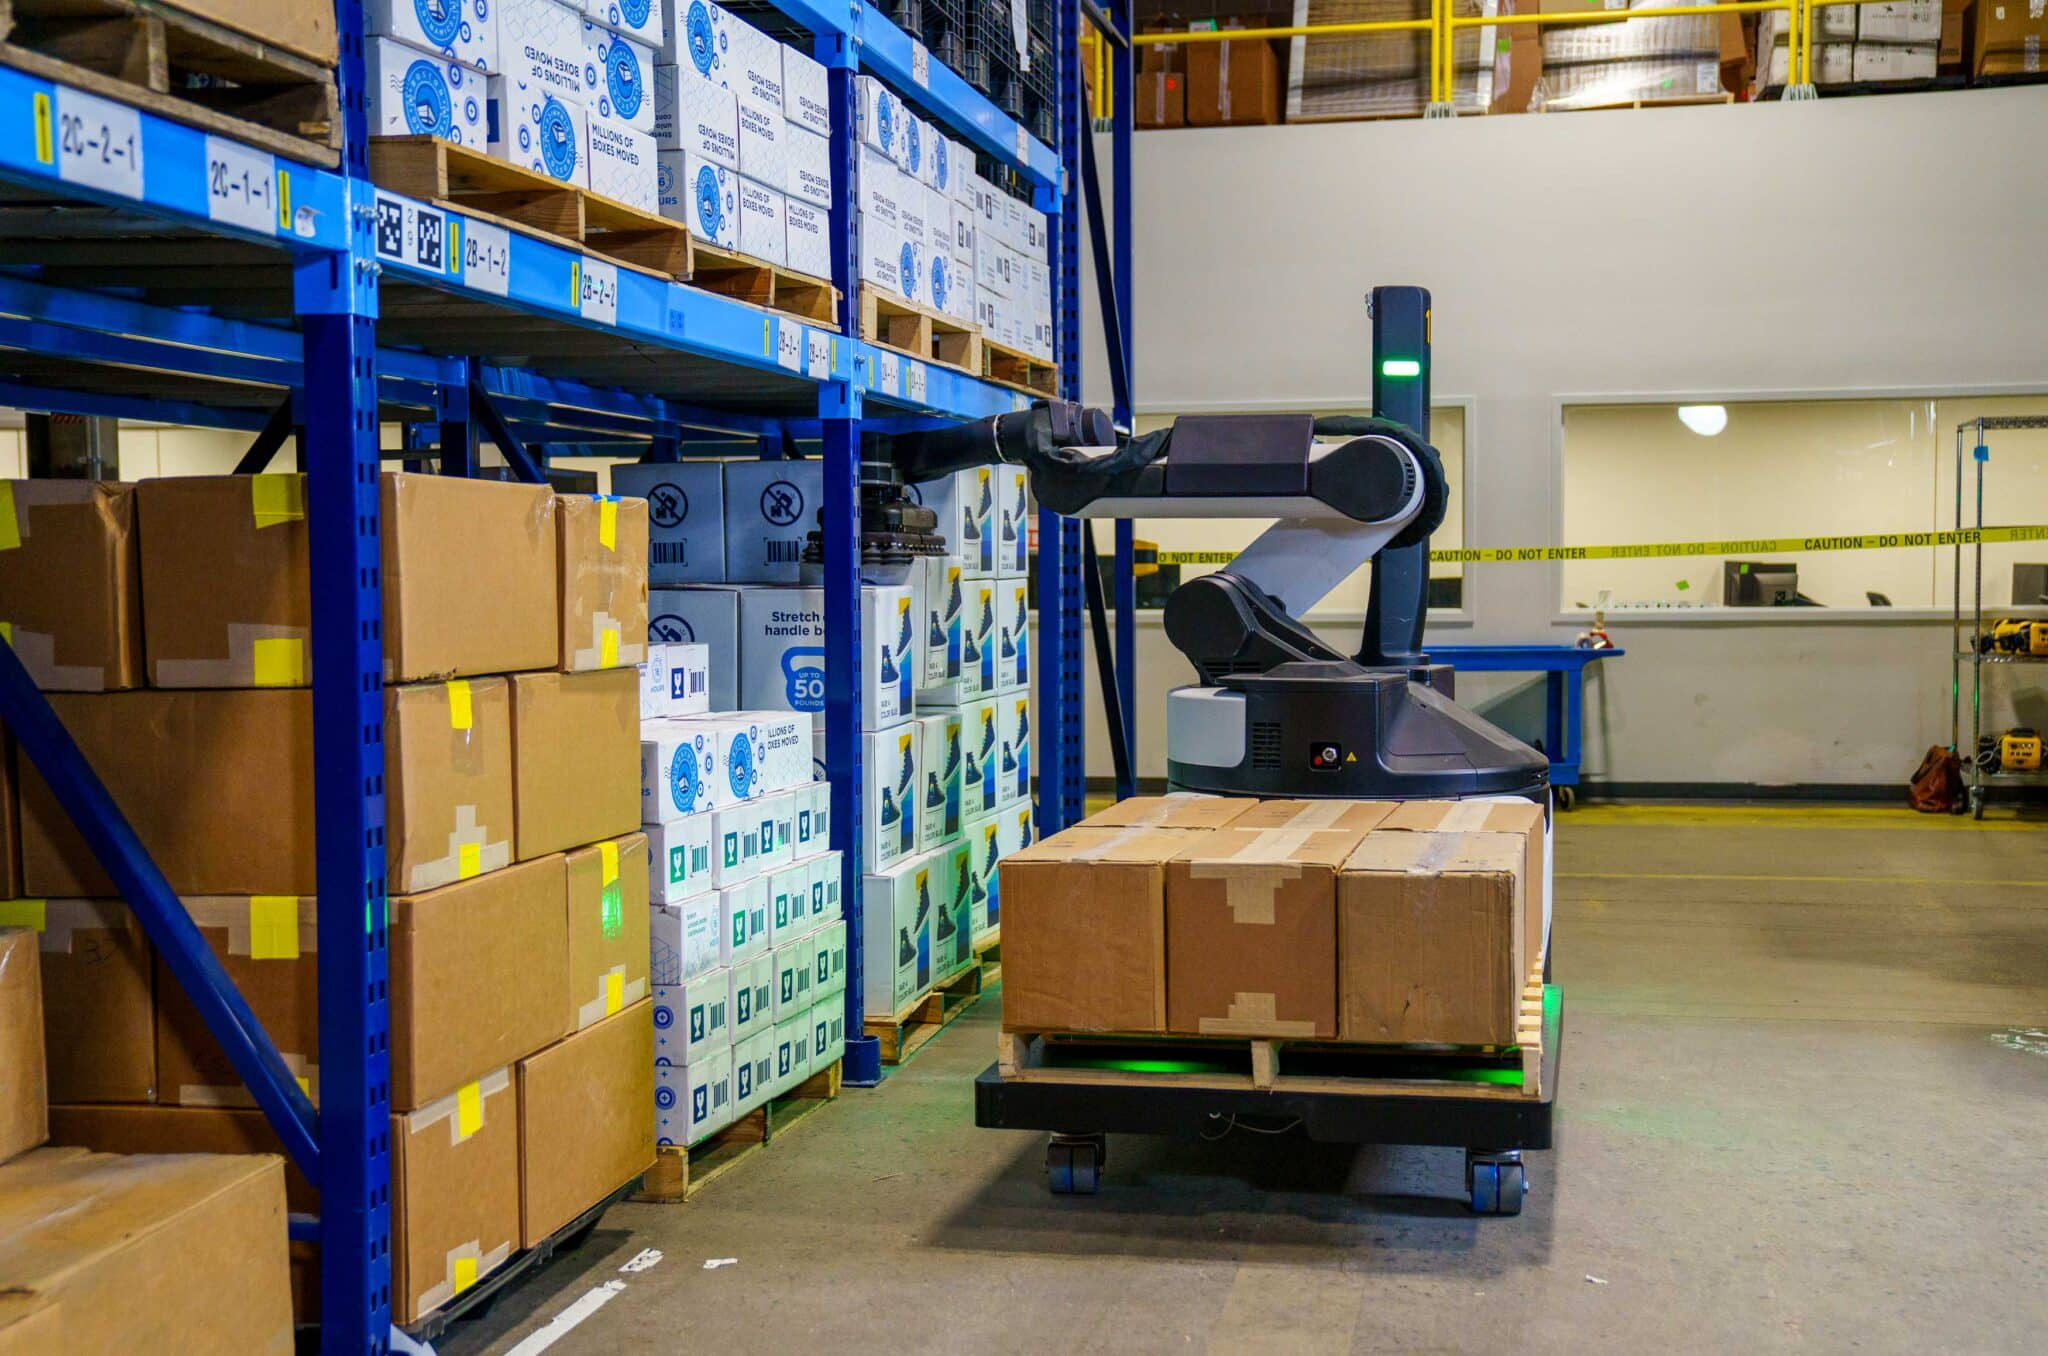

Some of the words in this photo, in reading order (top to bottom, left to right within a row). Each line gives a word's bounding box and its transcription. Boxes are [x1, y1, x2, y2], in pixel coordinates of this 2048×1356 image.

[524, 46, 552, 64] MOVED
[532, 66, 542, 78] OF
[554, 56, 580, 78] BOXES
[544, 71, 580, 92] MILLIONS
[740, 105, 764, 123] MILLIONS
[764, 117, 770, 126] OF
[592, 124, 623, 146] MILLIONS
[624, 136, 634, 147] OF
[698, 124, 717, 140] MOVED
[742, 118, 758, 134] BOXES
[758, 127, 774, 141] MOVED
[61, 114, 136, 171] 2C-2-1
[702, 141, 710, 150] OF
[718, 132, 734, 148] BOXES
[592, 138, 614, 156] BOXES
[616, 149, 640, 166] MOVED
[712, 144, 735, 160] MILLIONS
[211, 160, 270, 209] 2C-1-1
[658, 196, 678, 205] URS
[407, 208, 413, 222] 2
[466, 237, 506, 277] 2B-1-2
[582, 274, 615, 308] 2B-2-2
[778, 330, 800, 358] 2B-2-1
[1804, 538, 1862, 551] CAUTION
[1880, 536, 1898, 548] DO
[1904, 534, 1932, 547] NOT
[1938, 532, 1982, 546] ENTER
[1159, 552, 1166, 560] O
[1172, 552, 1194, 562] NOT
[1198, 552, 1232, 563] ENTER
[1430, 550, 1480, 562] CAUTION
[1496, 548, 1512, 560] DO
[1518, 548, 1542, 560] NOT
[1548, 546, 1586, 560] ENTER
[772, 611, 820, 622] Stretch
[765, 625, 810, 636] handle
[814, 625, 824, 636] b
[794, 680, 824, 698] 50
[768, 727, 787, 739] ILLIONS
[788, 725, 795, 734] OF
[768, 739, 781, 750] OXES
[782, 735, 798, 746] MOVED
